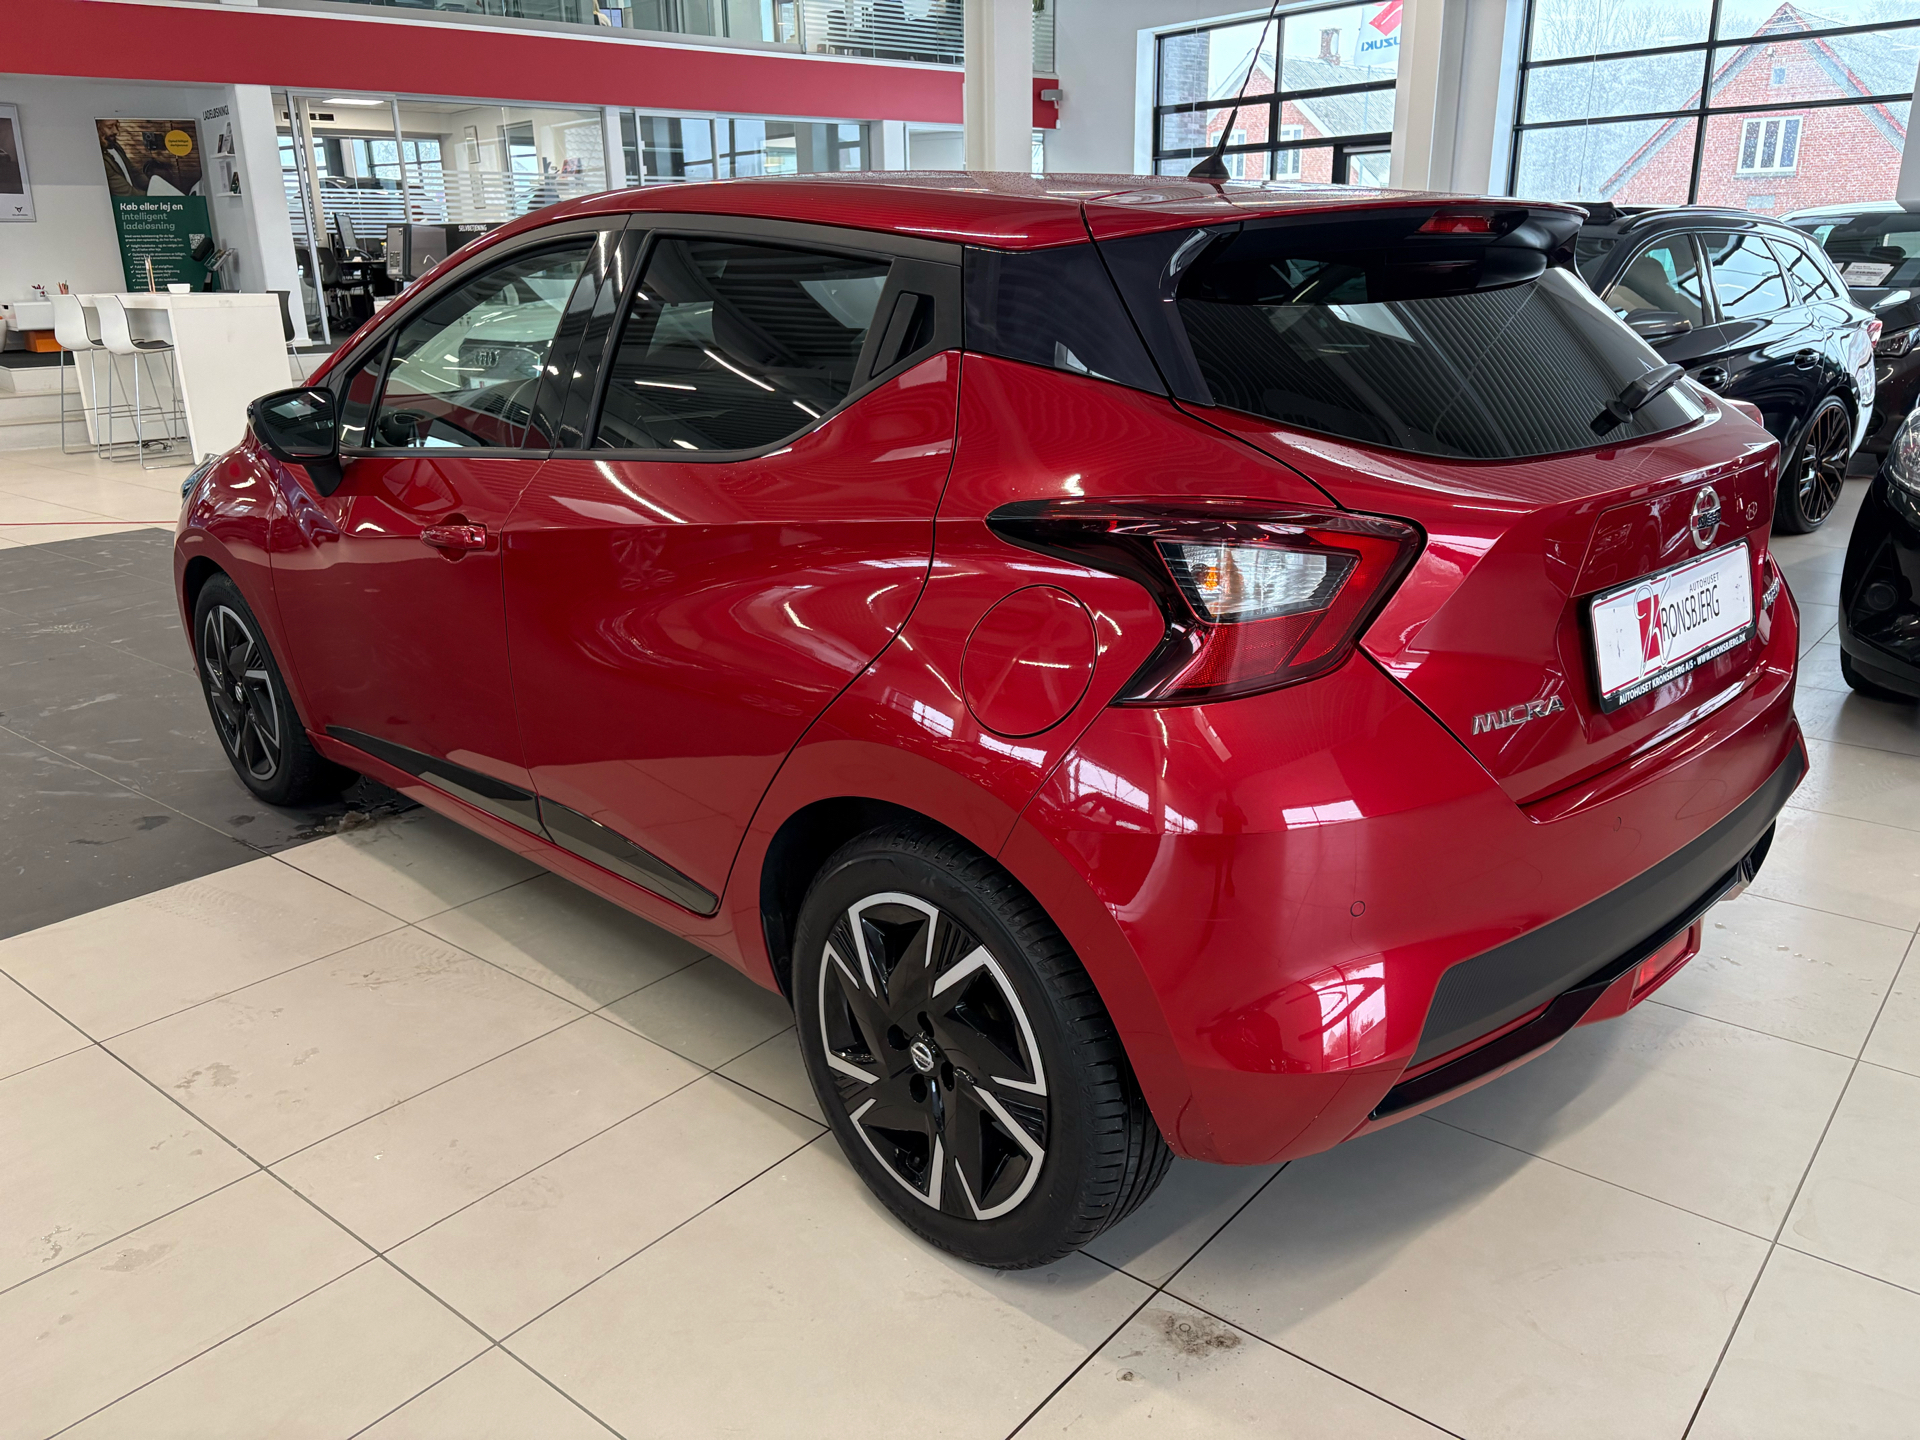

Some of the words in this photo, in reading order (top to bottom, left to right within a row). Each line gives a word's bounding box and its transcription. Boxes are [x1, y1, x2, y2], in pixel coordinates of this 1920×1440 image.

[120, 203, 138, 211] Køb
[139, 202, 159, 211] eller
[160, 202, 171, 212] lej
[172, 203, 184, 211] en
[121, 212, 168, 222] intelligent
[123, 221, 176, 232] ladeløsning
[1689, 571, 1720, 594] AUTOHUSET
[1618, 679, 1652, 706] AUTOHUSET
[1651, 663, 1686, 690] KRONSBJERG
[1685, 659, 1694, 671] A/S
[1696, 632, 1747, 666] WWW.KRONSBJERG.DK
[1472, 694, 1566, 736] MICRA
